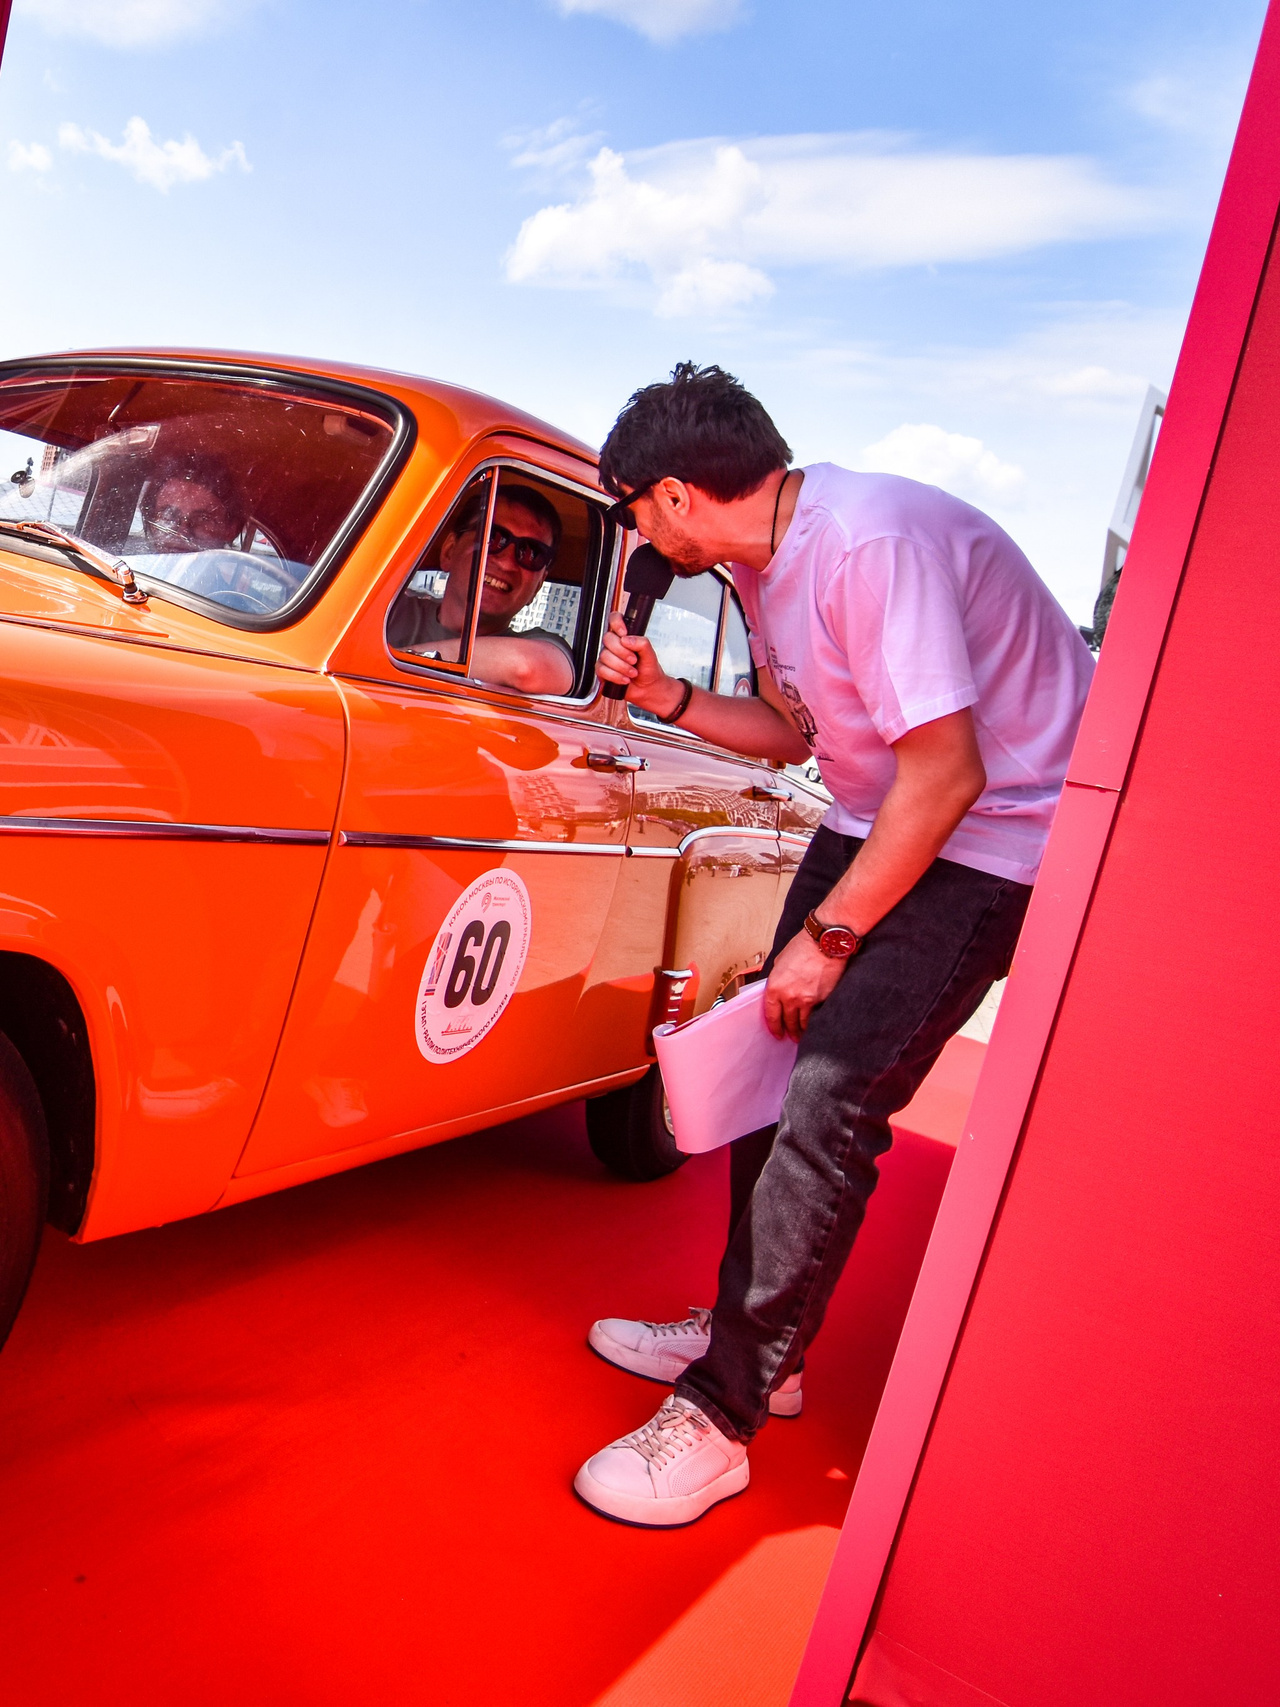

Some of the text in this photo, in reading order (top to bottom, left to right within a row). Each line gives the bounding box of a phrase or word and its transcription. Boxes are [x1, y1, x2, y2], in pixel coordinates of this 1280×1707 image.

[448, 897, 469, 927] КУБОК
[468, 877, 495, 901] МОСКВЫ
[494, 876, 504, 885] ПО
[444, 919, 511, 1009] 60
[490, 994, 508, 1022] МУЗЕЯ
